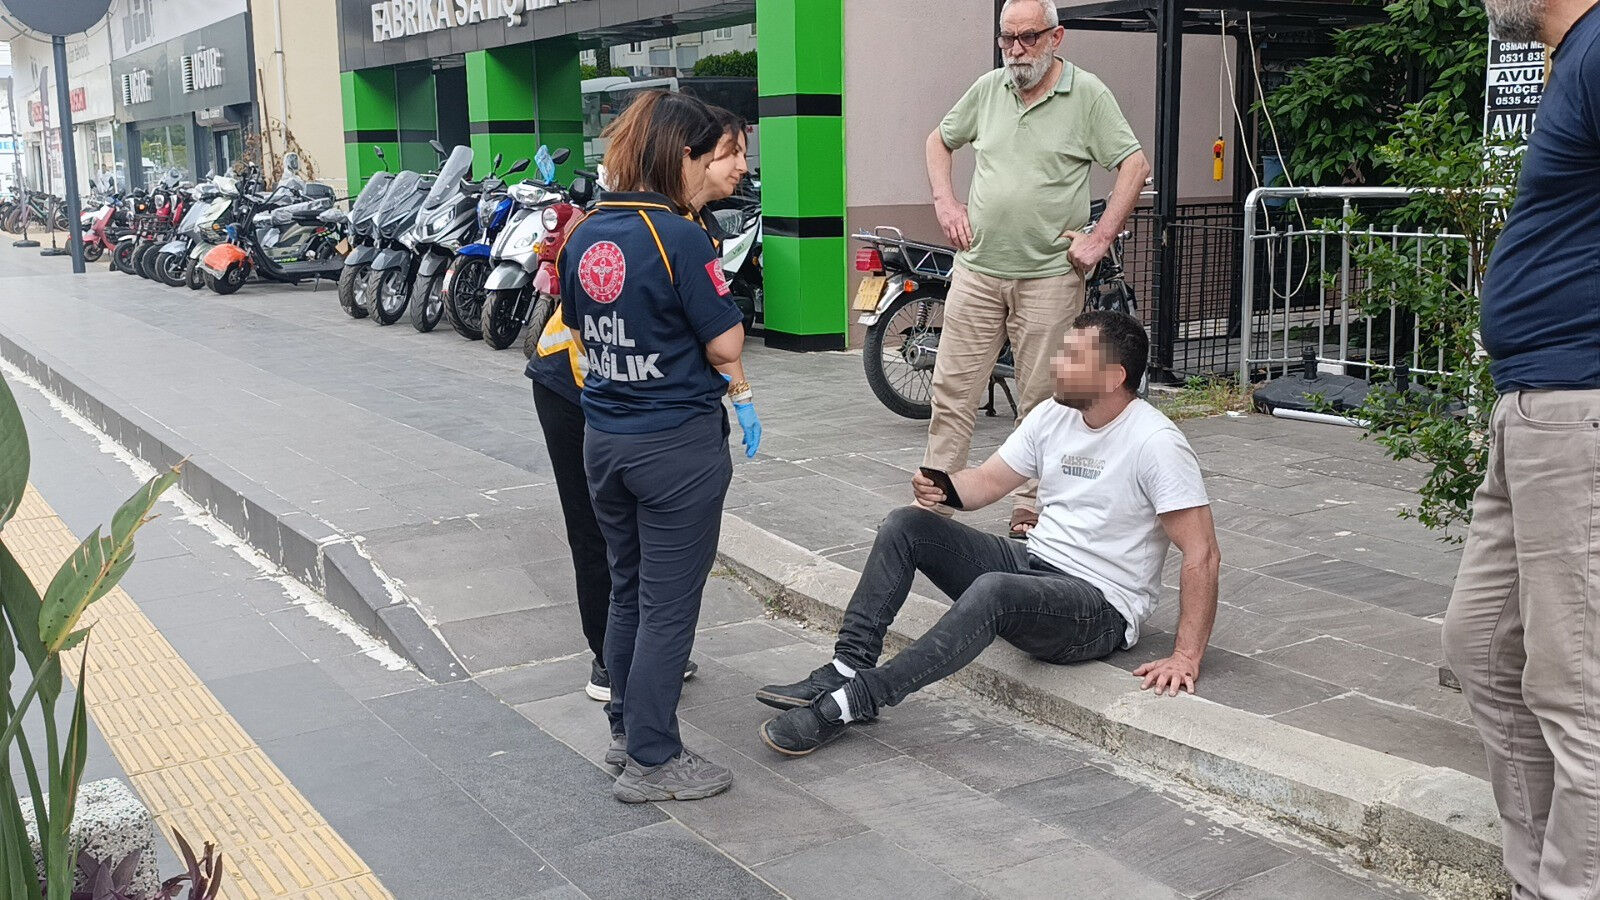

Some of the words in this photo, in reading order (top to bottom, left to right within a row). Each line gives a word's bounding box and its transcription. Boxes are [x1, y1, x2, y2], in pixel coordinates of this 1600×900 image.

[1500, 42, 1528, 51] OSMAN
[1500, 53, 1523, 63] 0531
[1497, 85, 1538, 95] TUĞÇE
[1495, 96, 1521, 105] 0535
[589, 345, 664, 381] AĞLIK
